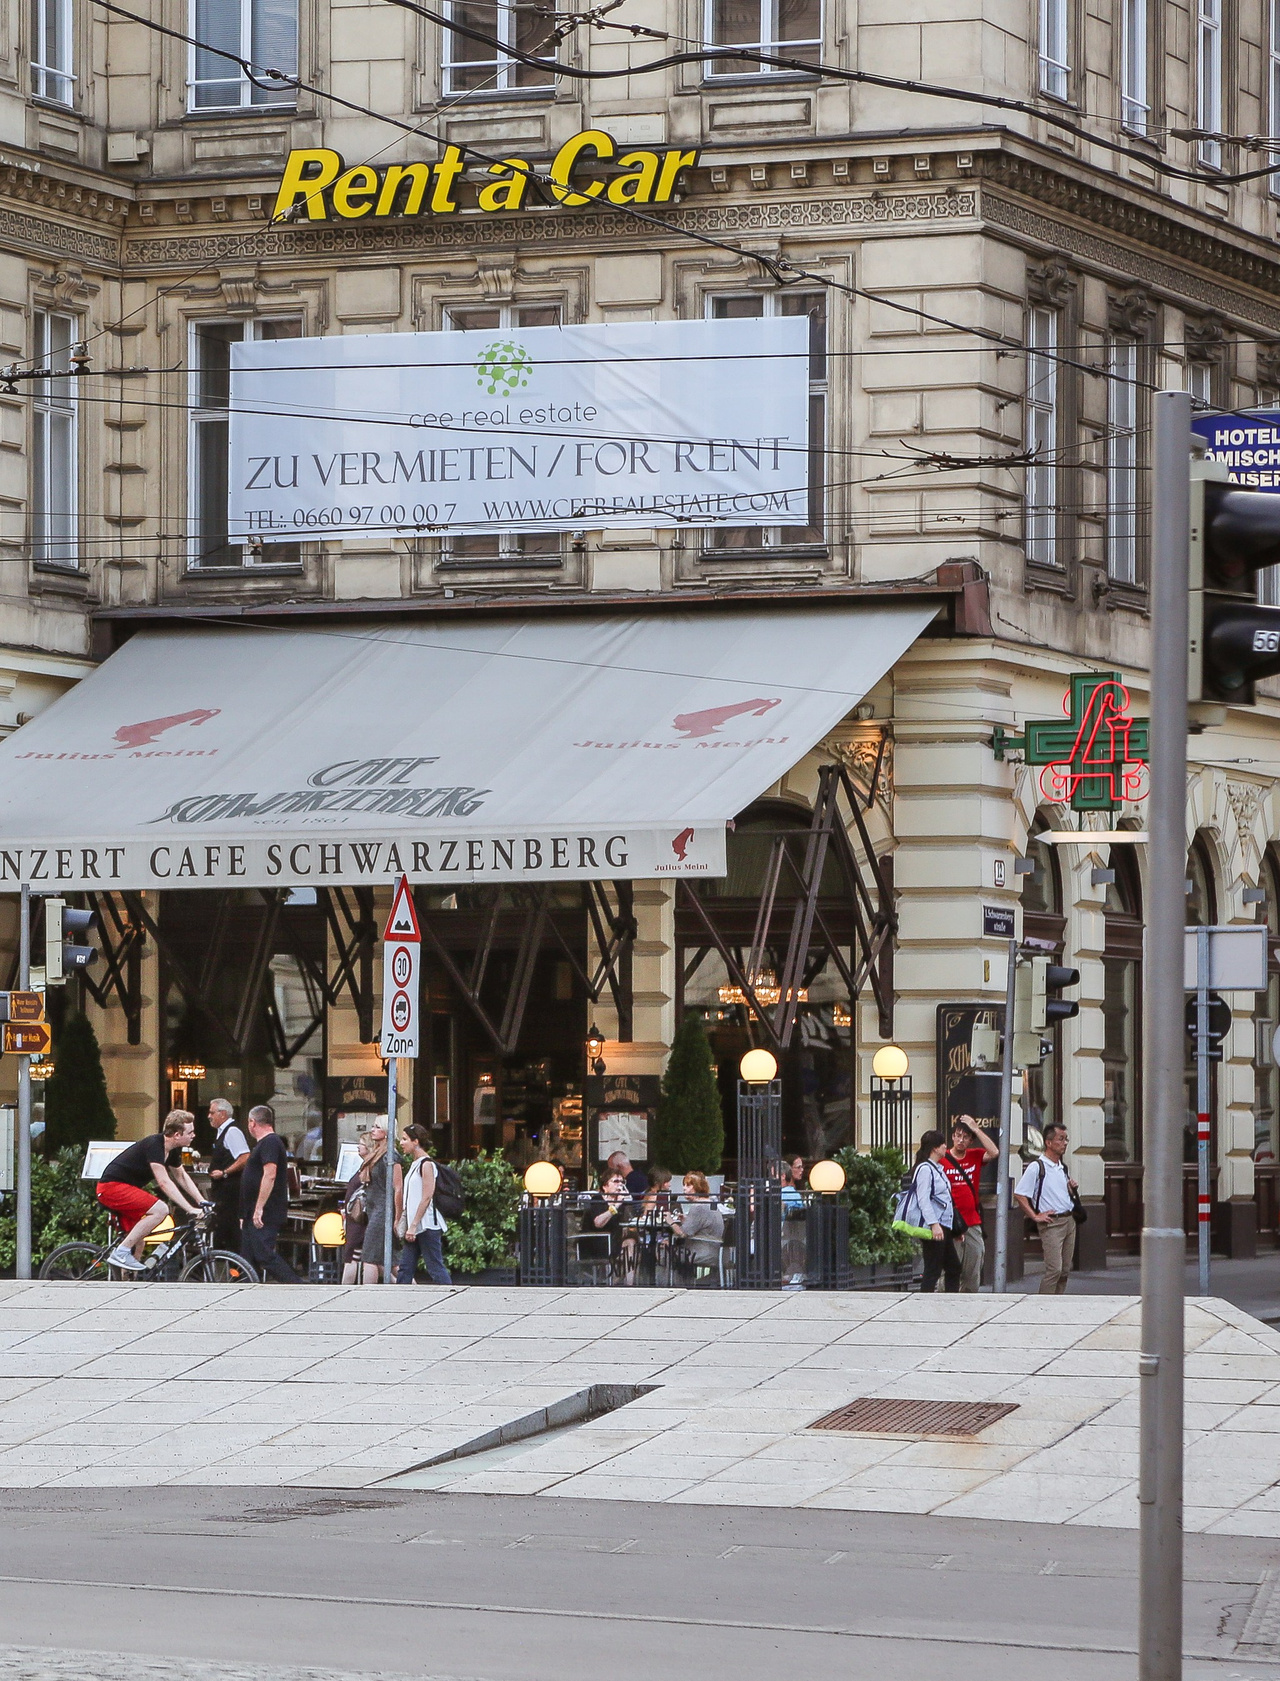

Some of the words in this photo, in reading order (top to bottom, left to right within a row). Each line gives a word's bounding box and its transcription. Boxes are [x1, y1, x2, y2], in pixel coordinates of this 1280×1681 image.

[272, 145, 466, 222] Rent
[478, 157, 532, 212] a
[551, 128, 701, 207] Car
[409, 412, 453, 428] cee
[462, 404, 510, 426] real
[520, 401, 597, 424] estate
[1215, 428, 1280, 446] HOTEL
[244, 455, 299, 490] ZU
[312, 445, 538, 486] VERMIETEN
[574, 441, 660, 477] FOR
[673, 436, 789, 473] RENT
[1204, 448, 1280, 467] ÖMISCH
[293, 506, 343, 528] 0660
[349, 505, 373, 526] 97
[380, 504, 406, 524] 00
[413, 503, 438, 523] 00
[444, 502, 457, 522] 7
[1255, 631, 1279, 651] 56
[573, 739, 681, 750] Julius
[695, 736, 789, 749] Meinl
[15, 751, 117, 760] Julius
[128, 748, 219, 759] Meinl
[149, 845, 247, 878] CAFE
[266, 835, 629, 876] SCHWARZENBERG
[397, 957, 407, 977] 30
[386, 1033, 414, 1054] Zone
